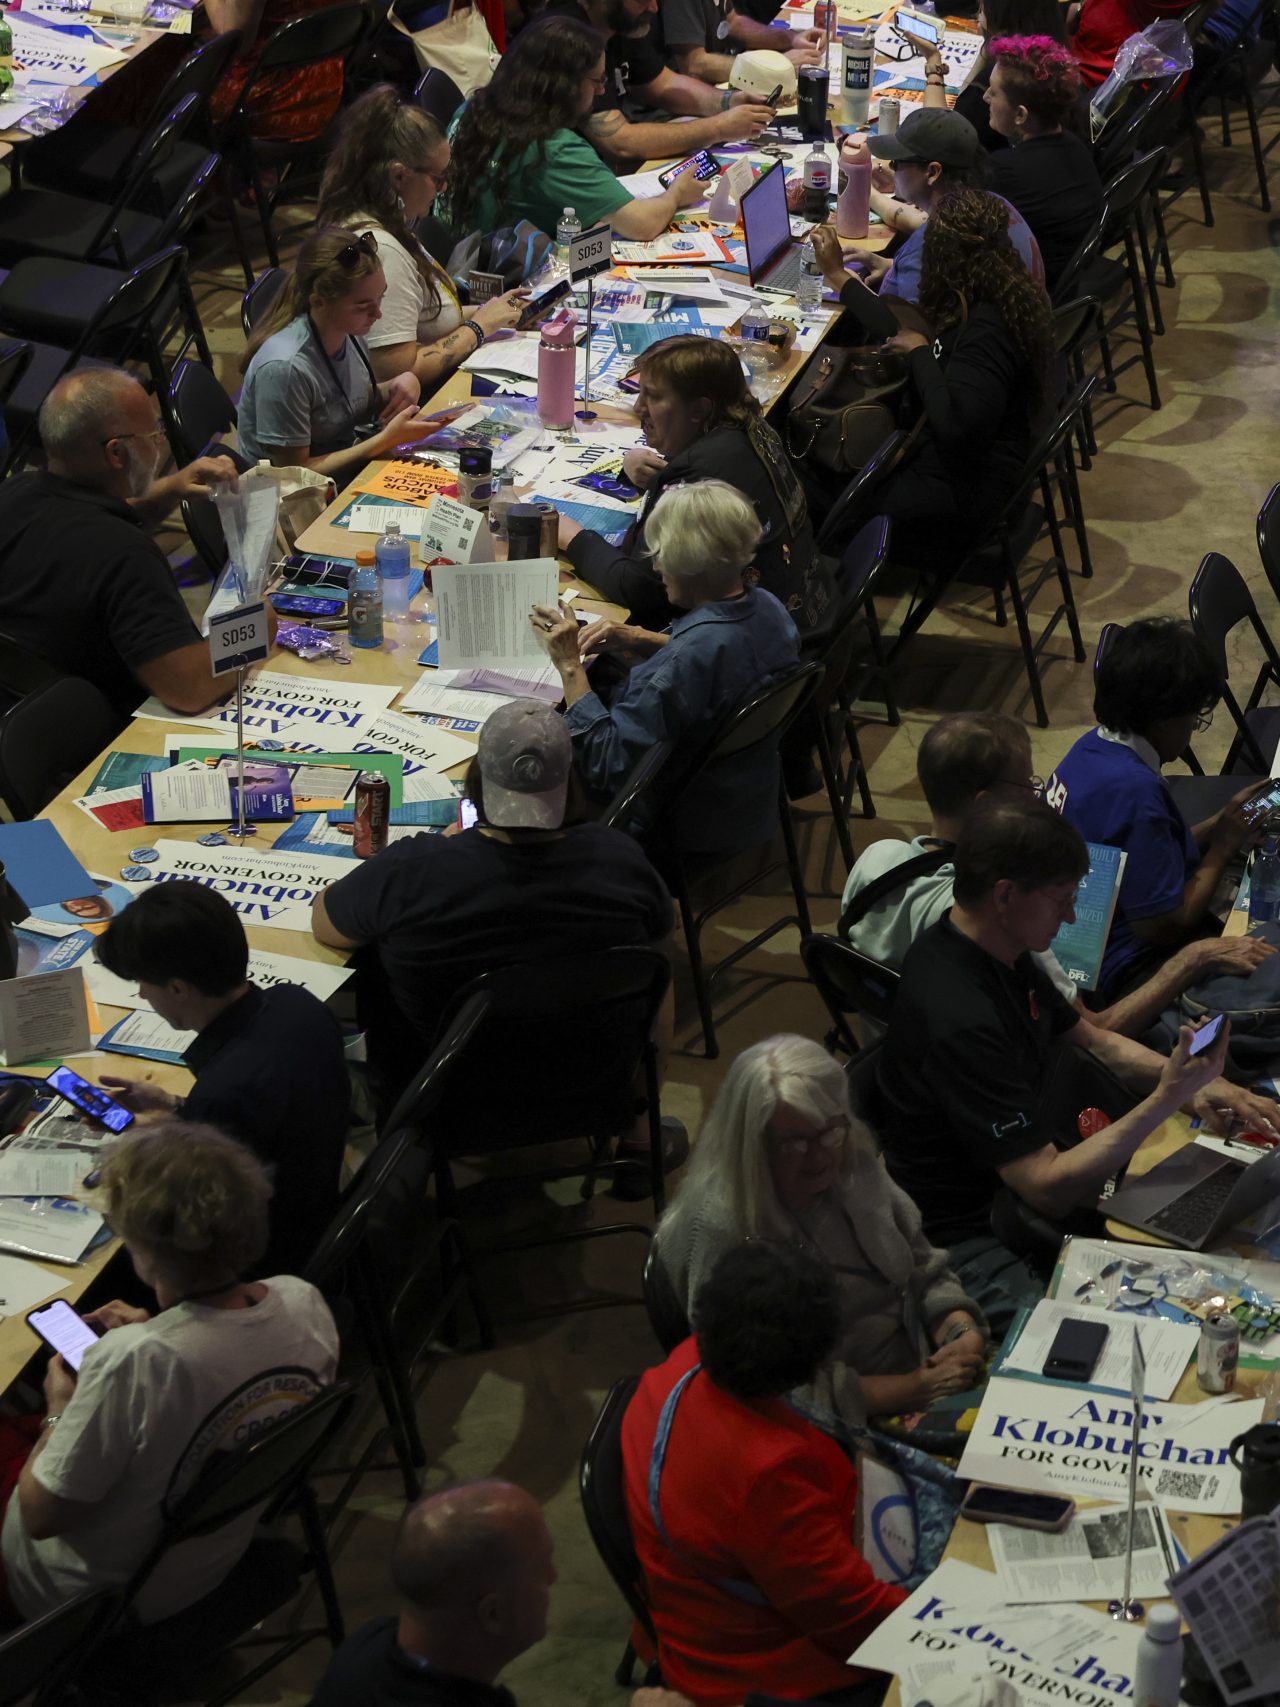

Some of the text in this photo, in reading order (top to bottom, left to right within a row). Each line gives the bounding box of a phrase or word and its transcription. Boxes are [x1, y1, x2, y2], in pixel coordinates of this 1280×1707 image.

[56, 53, 87, 63] FOR
[578, 241, 603, 261] SD53
[770, 314, 806, 325] FOR
[566, 443, 608, 470] Amy
[383, 475, 447, 492] AUCUS
[442, 501, 465, 513] Minnesota
[222, 623, 256, 648] SD53
[319, 694, 361, 709] FOR
[210, 710, 300, 734] Amy
[401, 742, 438, 761] FOR
[371, 790, 384, 828] START
[175, 858, 307, 884] GOVERNOR
[220, 855, 320, 871] AmyKlobuchar.com
[246, 1381, 271, 1404] FOR
[1001, 1446, 1054, 1465] FOR
[1044, 1471, 1128, 1490] AmyKlobucha
